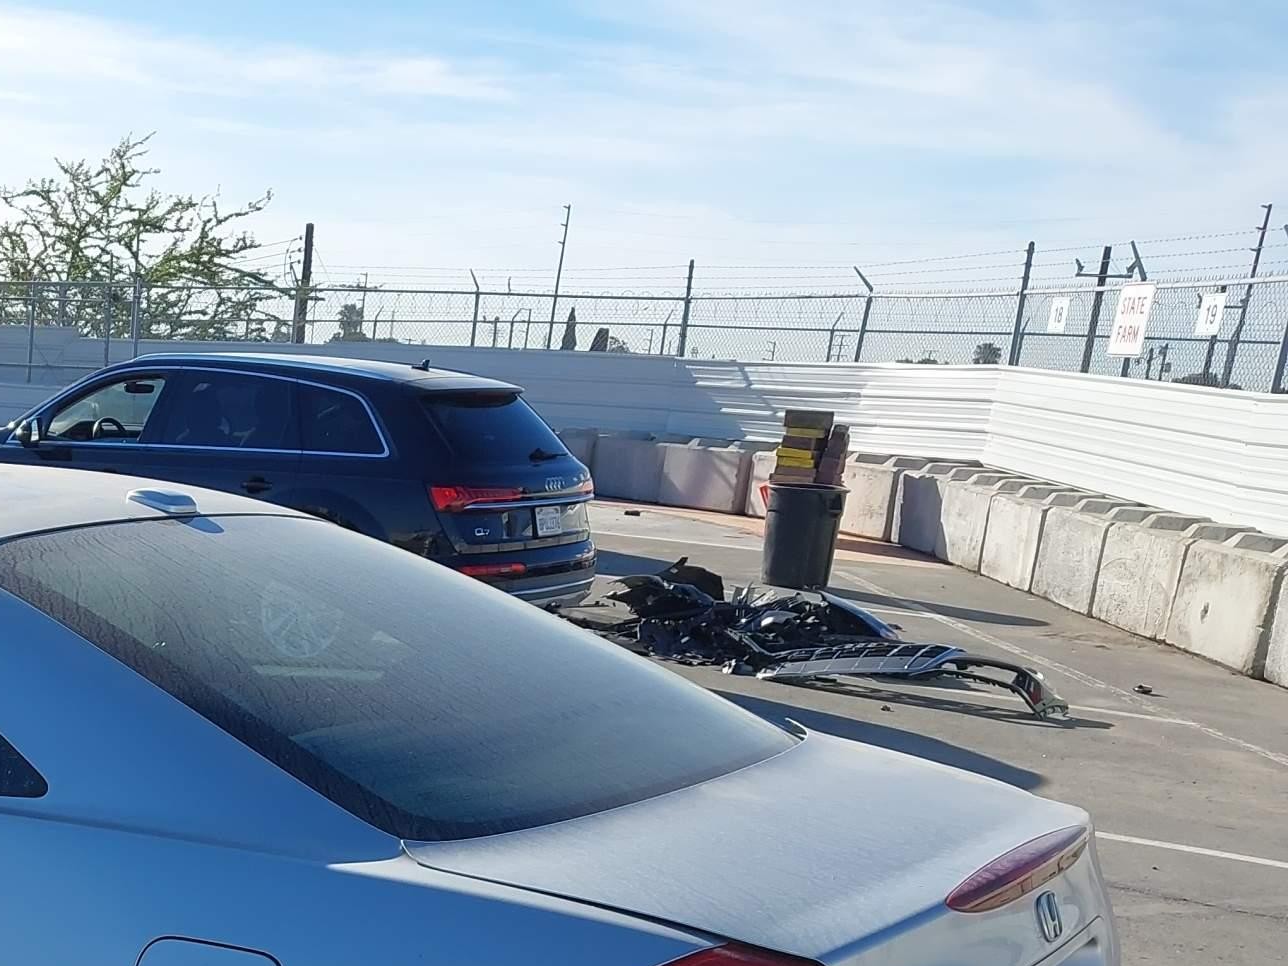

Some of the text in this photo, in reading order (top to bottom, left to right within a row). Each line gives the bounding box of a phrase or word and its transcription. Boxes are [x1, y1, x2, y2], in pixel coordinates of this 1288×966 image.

[1054, 306, 1064, 324] 18
[1121, 296, 1147, 315] STATE
[1204, 304, 1218, 325] 19
[1115, 325, 1140, 344] FARM
[474, 527, 490, 536] Q7
